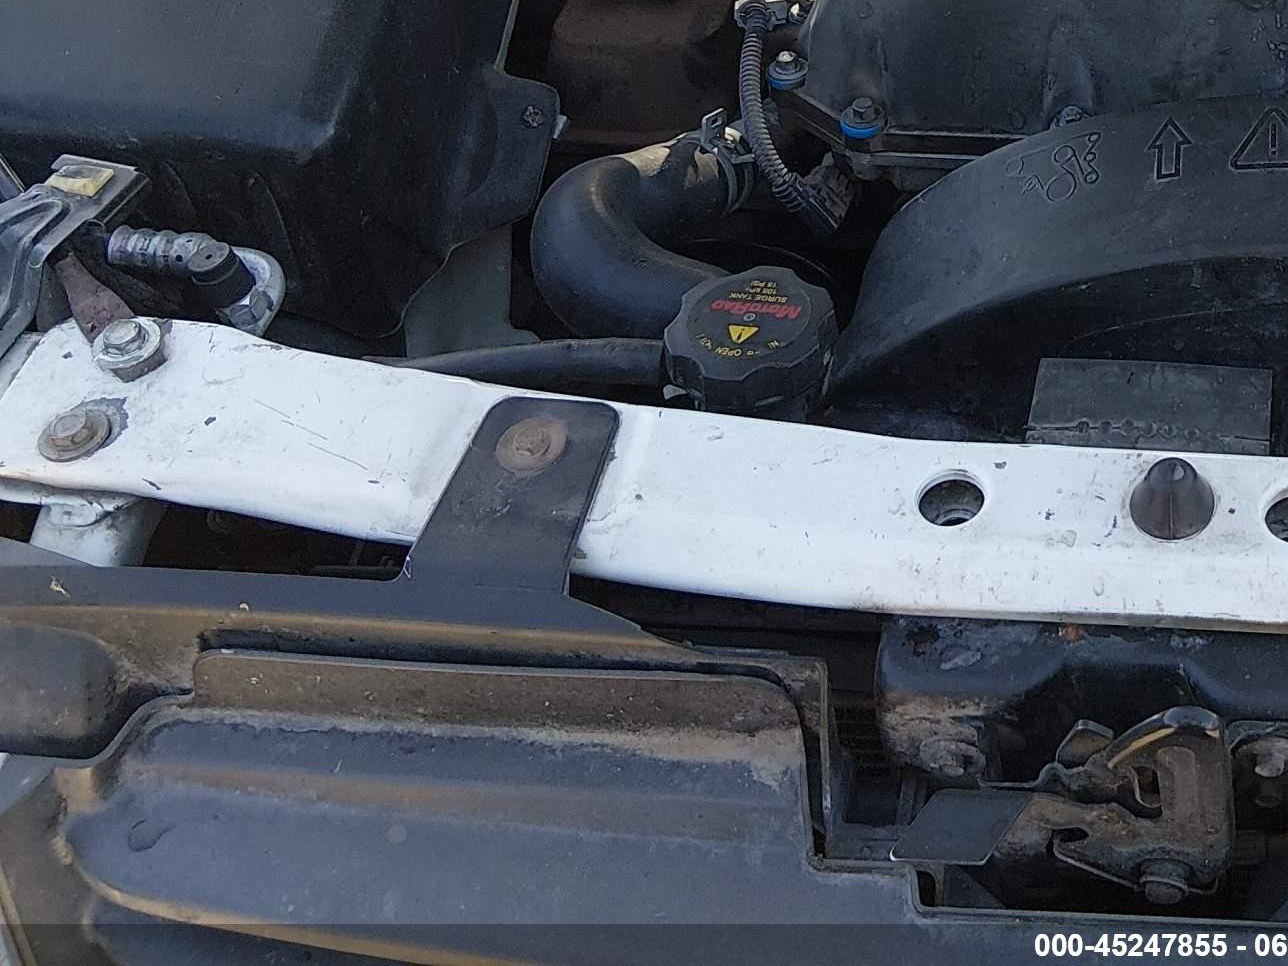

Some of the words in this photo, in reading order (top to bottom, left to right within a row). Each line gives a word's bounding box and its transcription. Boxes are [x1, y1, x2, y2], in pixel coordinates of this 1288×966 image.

[729, 291, 755, 300] TANK
[754, 294, 789, 303] SURGE
[715, 346, 743, 357] OPEN
